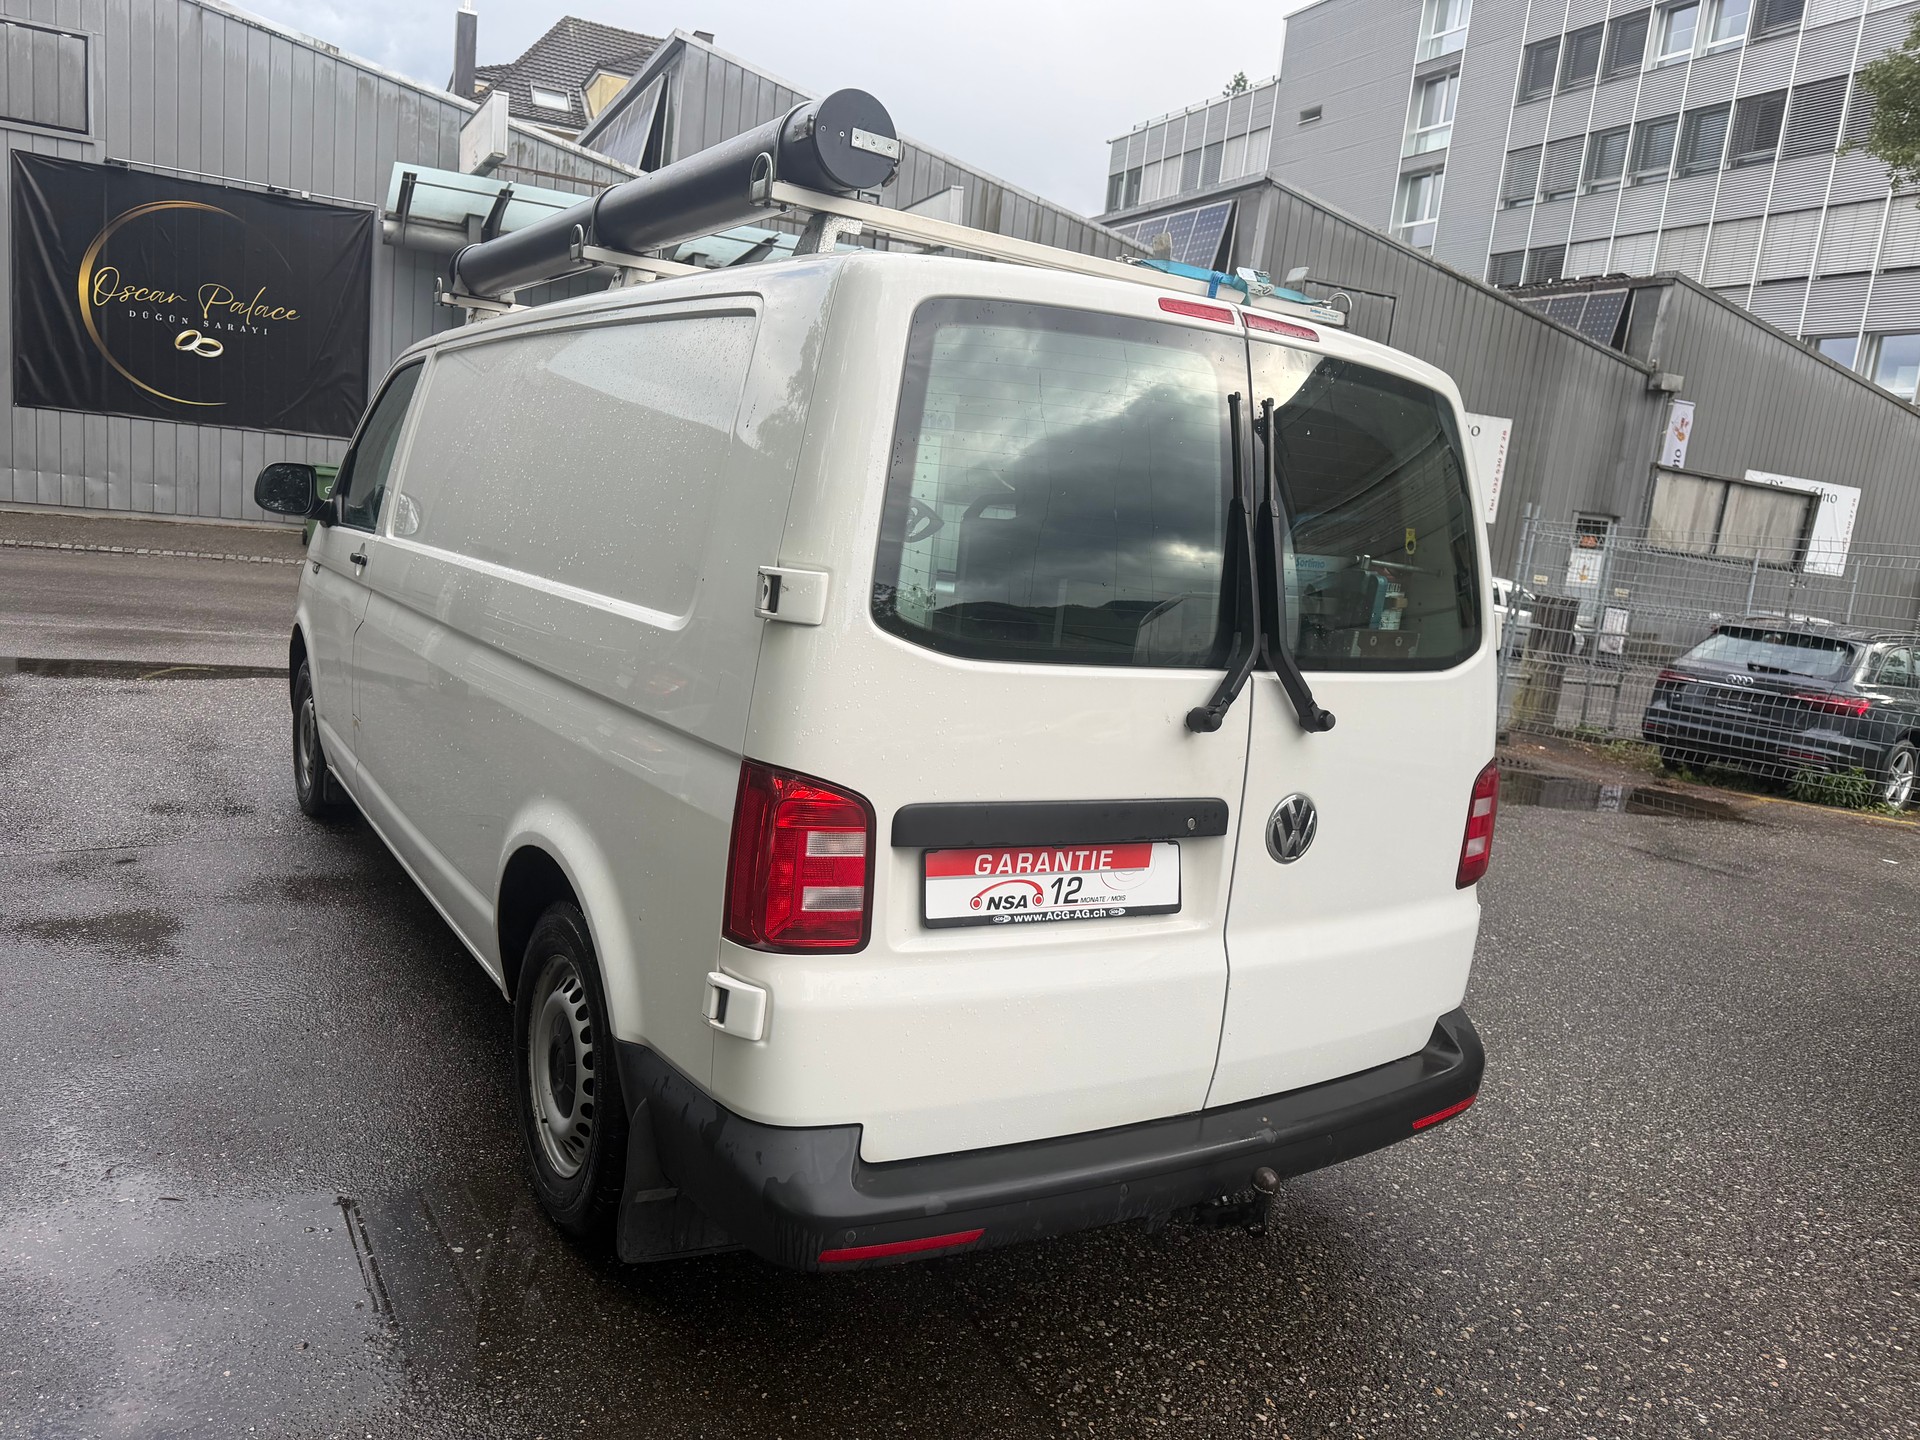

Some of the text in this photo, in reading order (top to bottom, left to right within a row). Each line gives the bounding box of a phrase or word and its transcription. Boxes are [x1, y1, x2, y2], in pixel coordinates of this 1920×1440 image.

[93, 266, 300, 325] Oscar Palace
[203, 319, 268, 335] SARAYI
[974, 849, 1114, 876] GARANTIE
[986, 895, 1028, 911] NSA
[1050, 876, 1083, 905] 12
[1014, 908, 1107, 922] www.ACG-AG.ch
